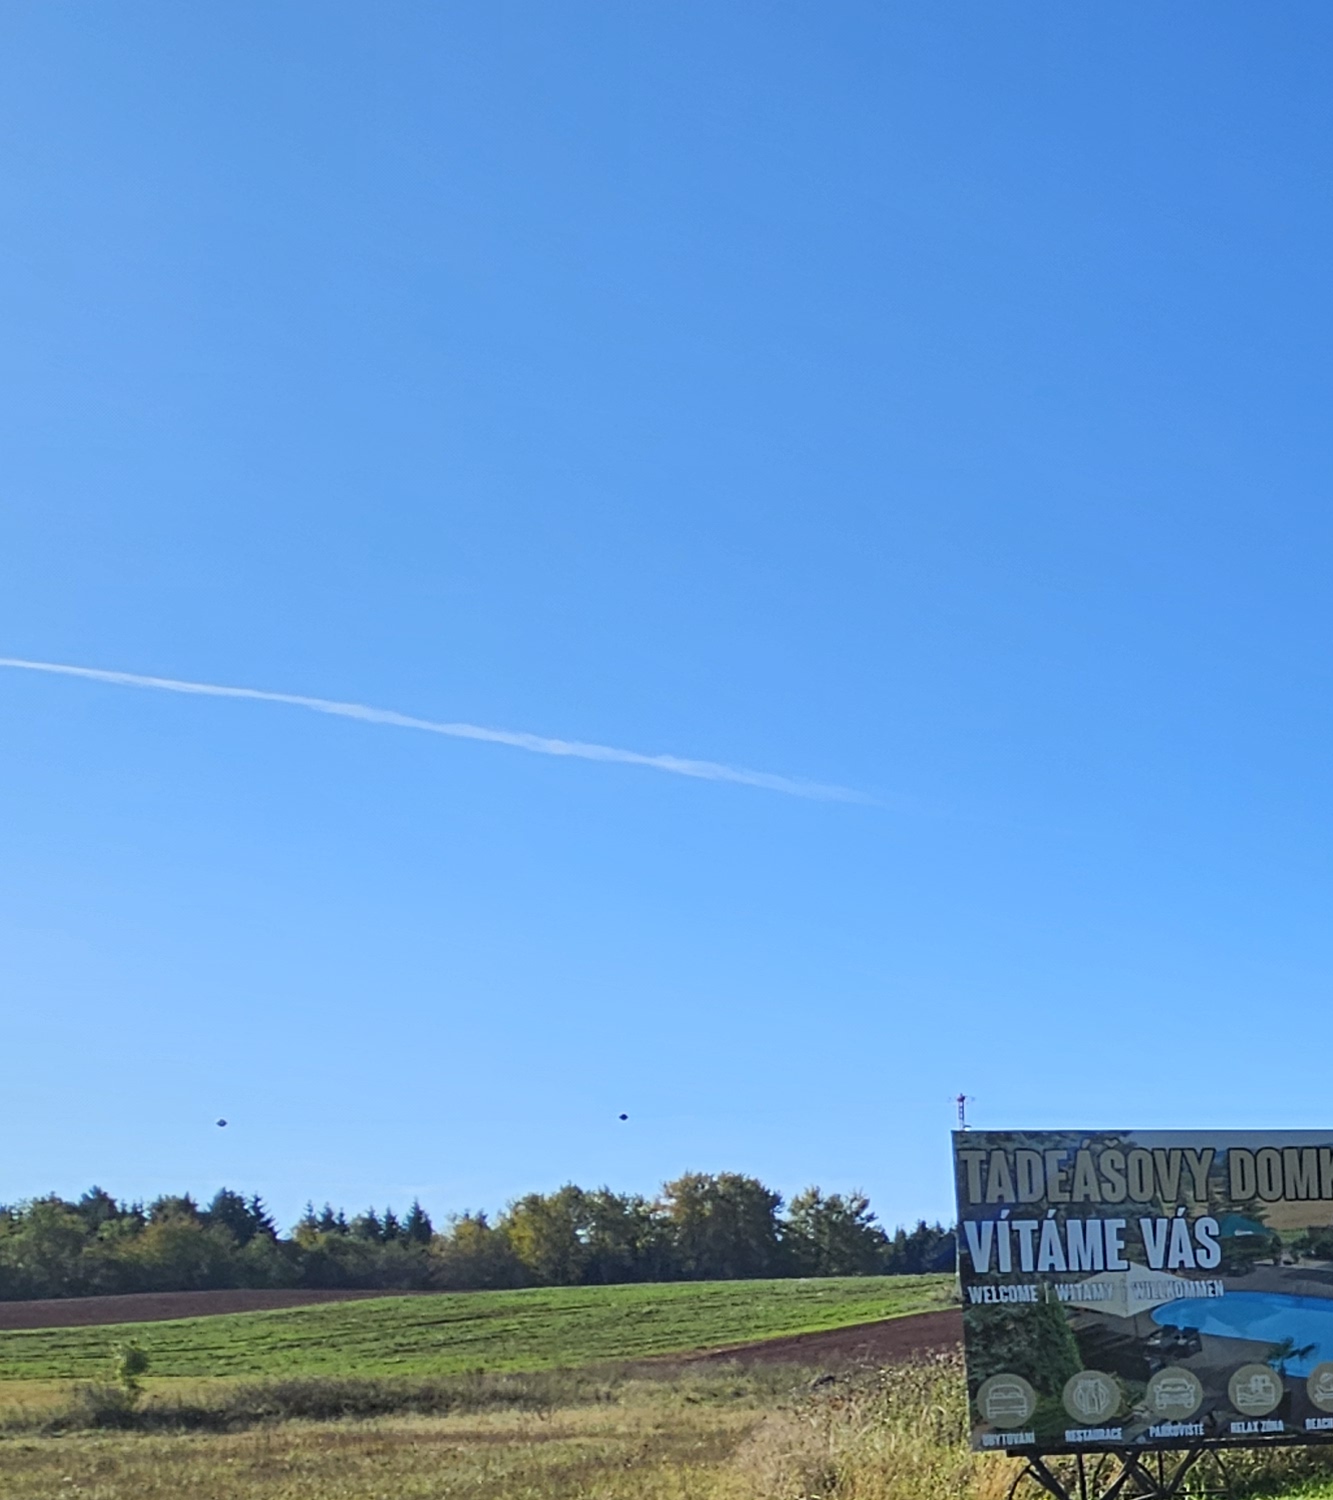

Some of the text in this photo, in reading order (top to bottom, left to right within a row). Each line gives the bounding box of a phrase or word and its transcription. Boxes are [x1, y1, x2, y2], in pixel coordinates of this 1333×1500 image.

[959, 1138, 1215, 1204] TADEÁŠOVY
[963, 1206, 1222, 1273] VÍTÁME VÁS
[967, 1280, 1224, 1304] WELCOME WITAMY WILLKOMMEN
[1065, 1427, 1123, 1442] RESTAURACE
[1230, 1421, 1258, 1433] RELAX
